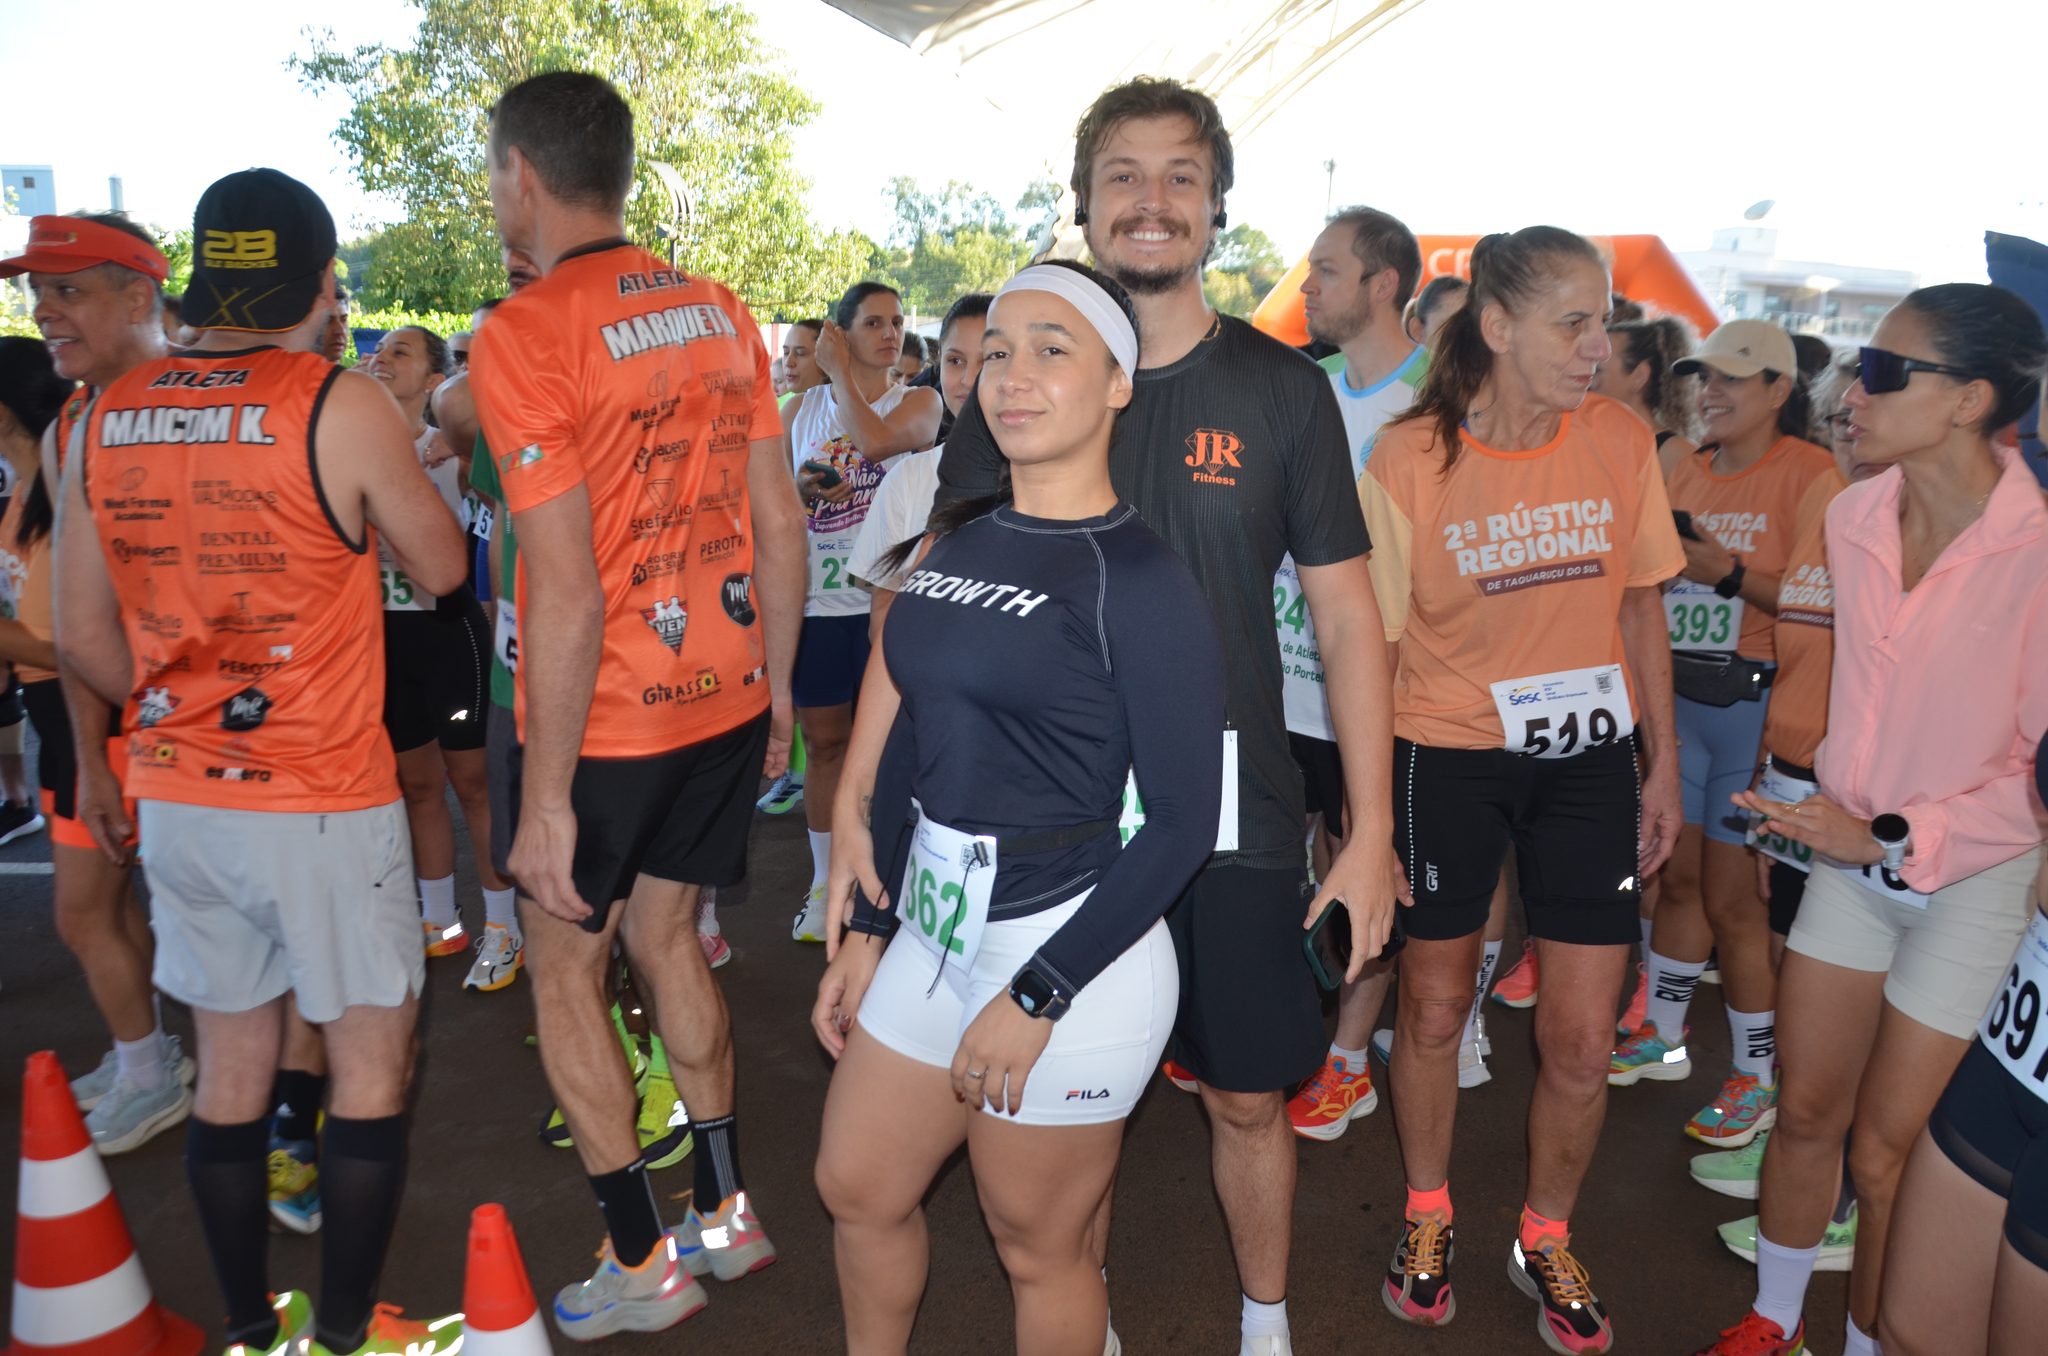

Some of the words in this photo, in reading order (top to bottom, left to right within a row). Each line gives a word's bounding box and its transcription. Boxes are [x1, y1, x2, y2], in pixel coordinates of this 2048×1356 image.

[617, 270, 691, 296] ATLETA
[148, 369, 252, 389] ATLETA
[101, 405, 234, 448] MAICOM
[237, 404, 276, 444] K.
[631, 405, 658, 422] Med
[1185, 431, 1242, 468] JR
[848, 466, 879, 488] Não
[1193, 472, 1236, 486] Fitness
[200, 531, 277, 546] DENTAL
[1443, 519, 1478, 551] 2ª
[1487, 498, 1614, 542] RÚSTICA
[197, 551, 287, 567] PREMIUM
[1456, 526, 1612, 577] REGIONAL
[1487, 581, 1501, 591] DE
[1504, 570, 1565, 587] TAQUARUÇU
[1566, 566, 1582, 577] DO
[1583, 563, 1600, 574] SUL
[900, 570, 1049, 617] GROWTH
[1670, 603, 1732, 644] 393
[1283, 642, 1294, 655] de
[1517, 707, 1618, 756] 519
[905, 852, 968, 956] 362
[1654, 969, 1702, 1002] RUN
[1065, 1088, 1111, 1101] FILA
